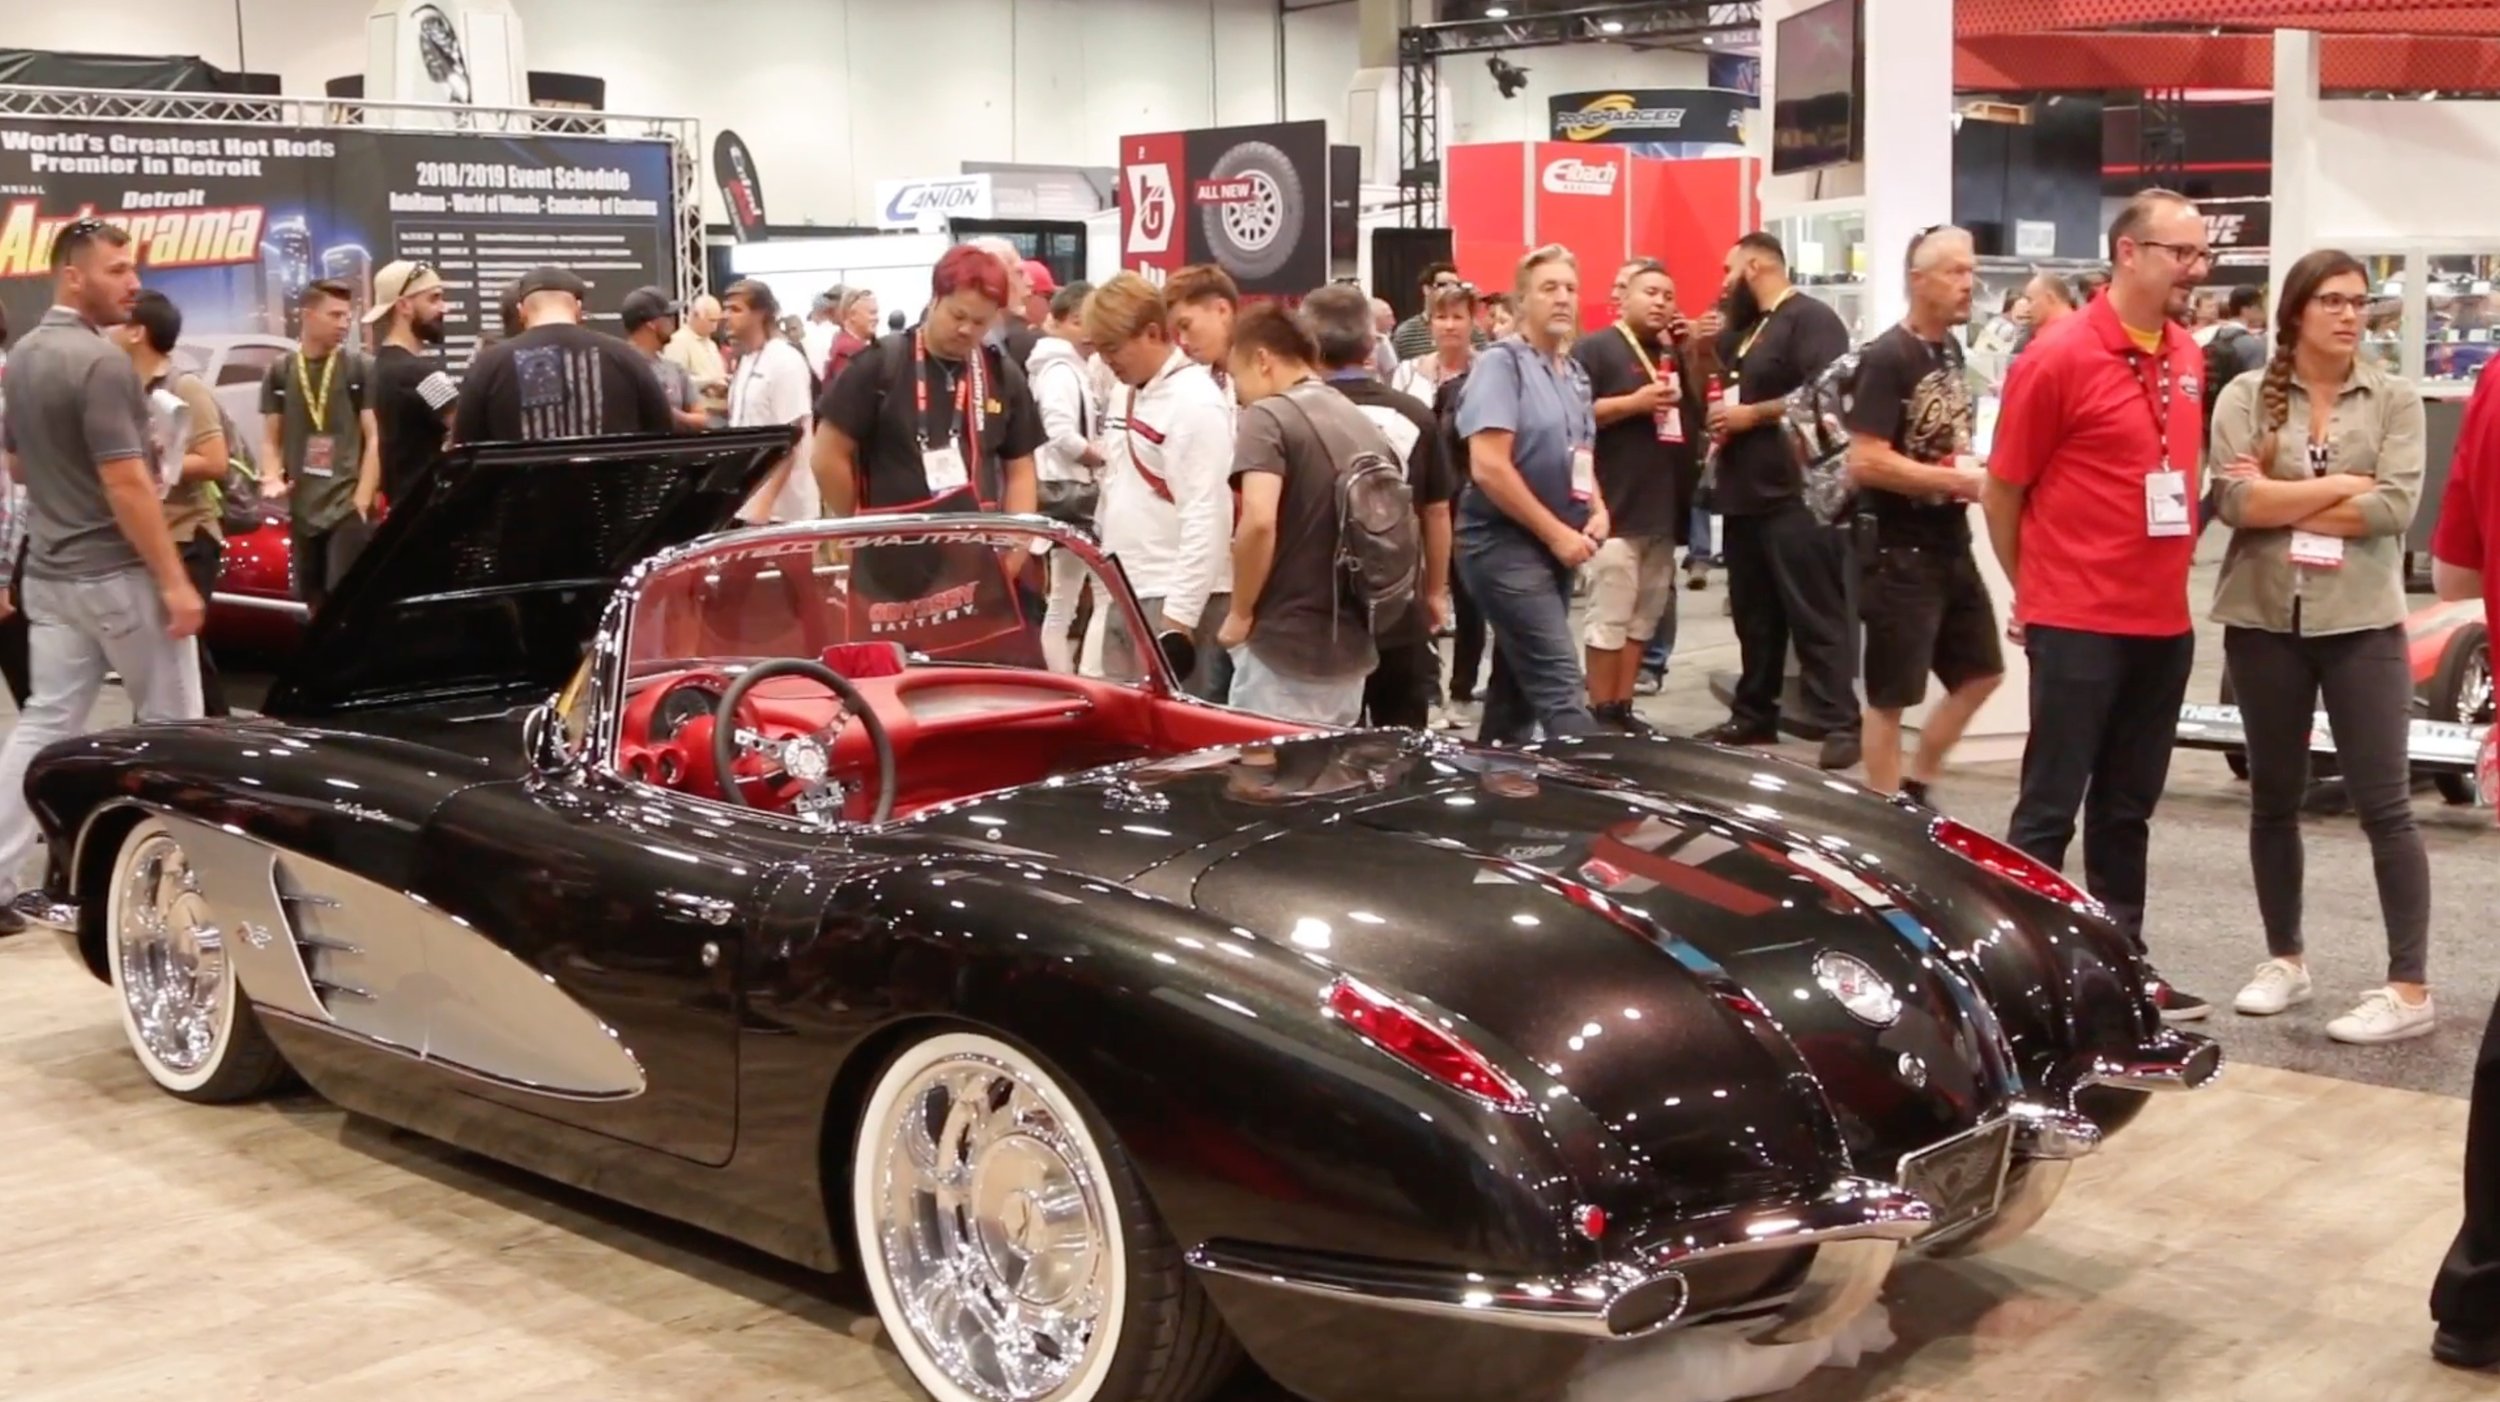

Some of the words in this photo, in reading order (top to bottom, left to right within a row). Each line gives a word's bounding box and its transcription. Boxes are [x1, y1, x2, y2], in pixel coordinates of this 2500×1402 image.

[1, 130, 105, 152] World's
[109, 133, 221, 156] Greatest
[223, 137, 269, 157] Hot
[273, 138, 336, 158] Rods
[30, 152, 138, 175] Premier
[142, 155, 169, 175] in
[172, 156, 262, 177] Detroit
[416, 161, 506, 188] 2018/2019
[507, 164, 553, 190] Event
[554, 166, 631, 191] Schedule
[1542, 157, 1618, 195] Eibach
[0, 184, 46, 195] NNUAL
[121, 189, 206, 209] Detroit
[1197, 185, 1219, 200] ALL
[1220, 183, 1250, 199] NEW
[871, 604, 975, 632] BATTERY
